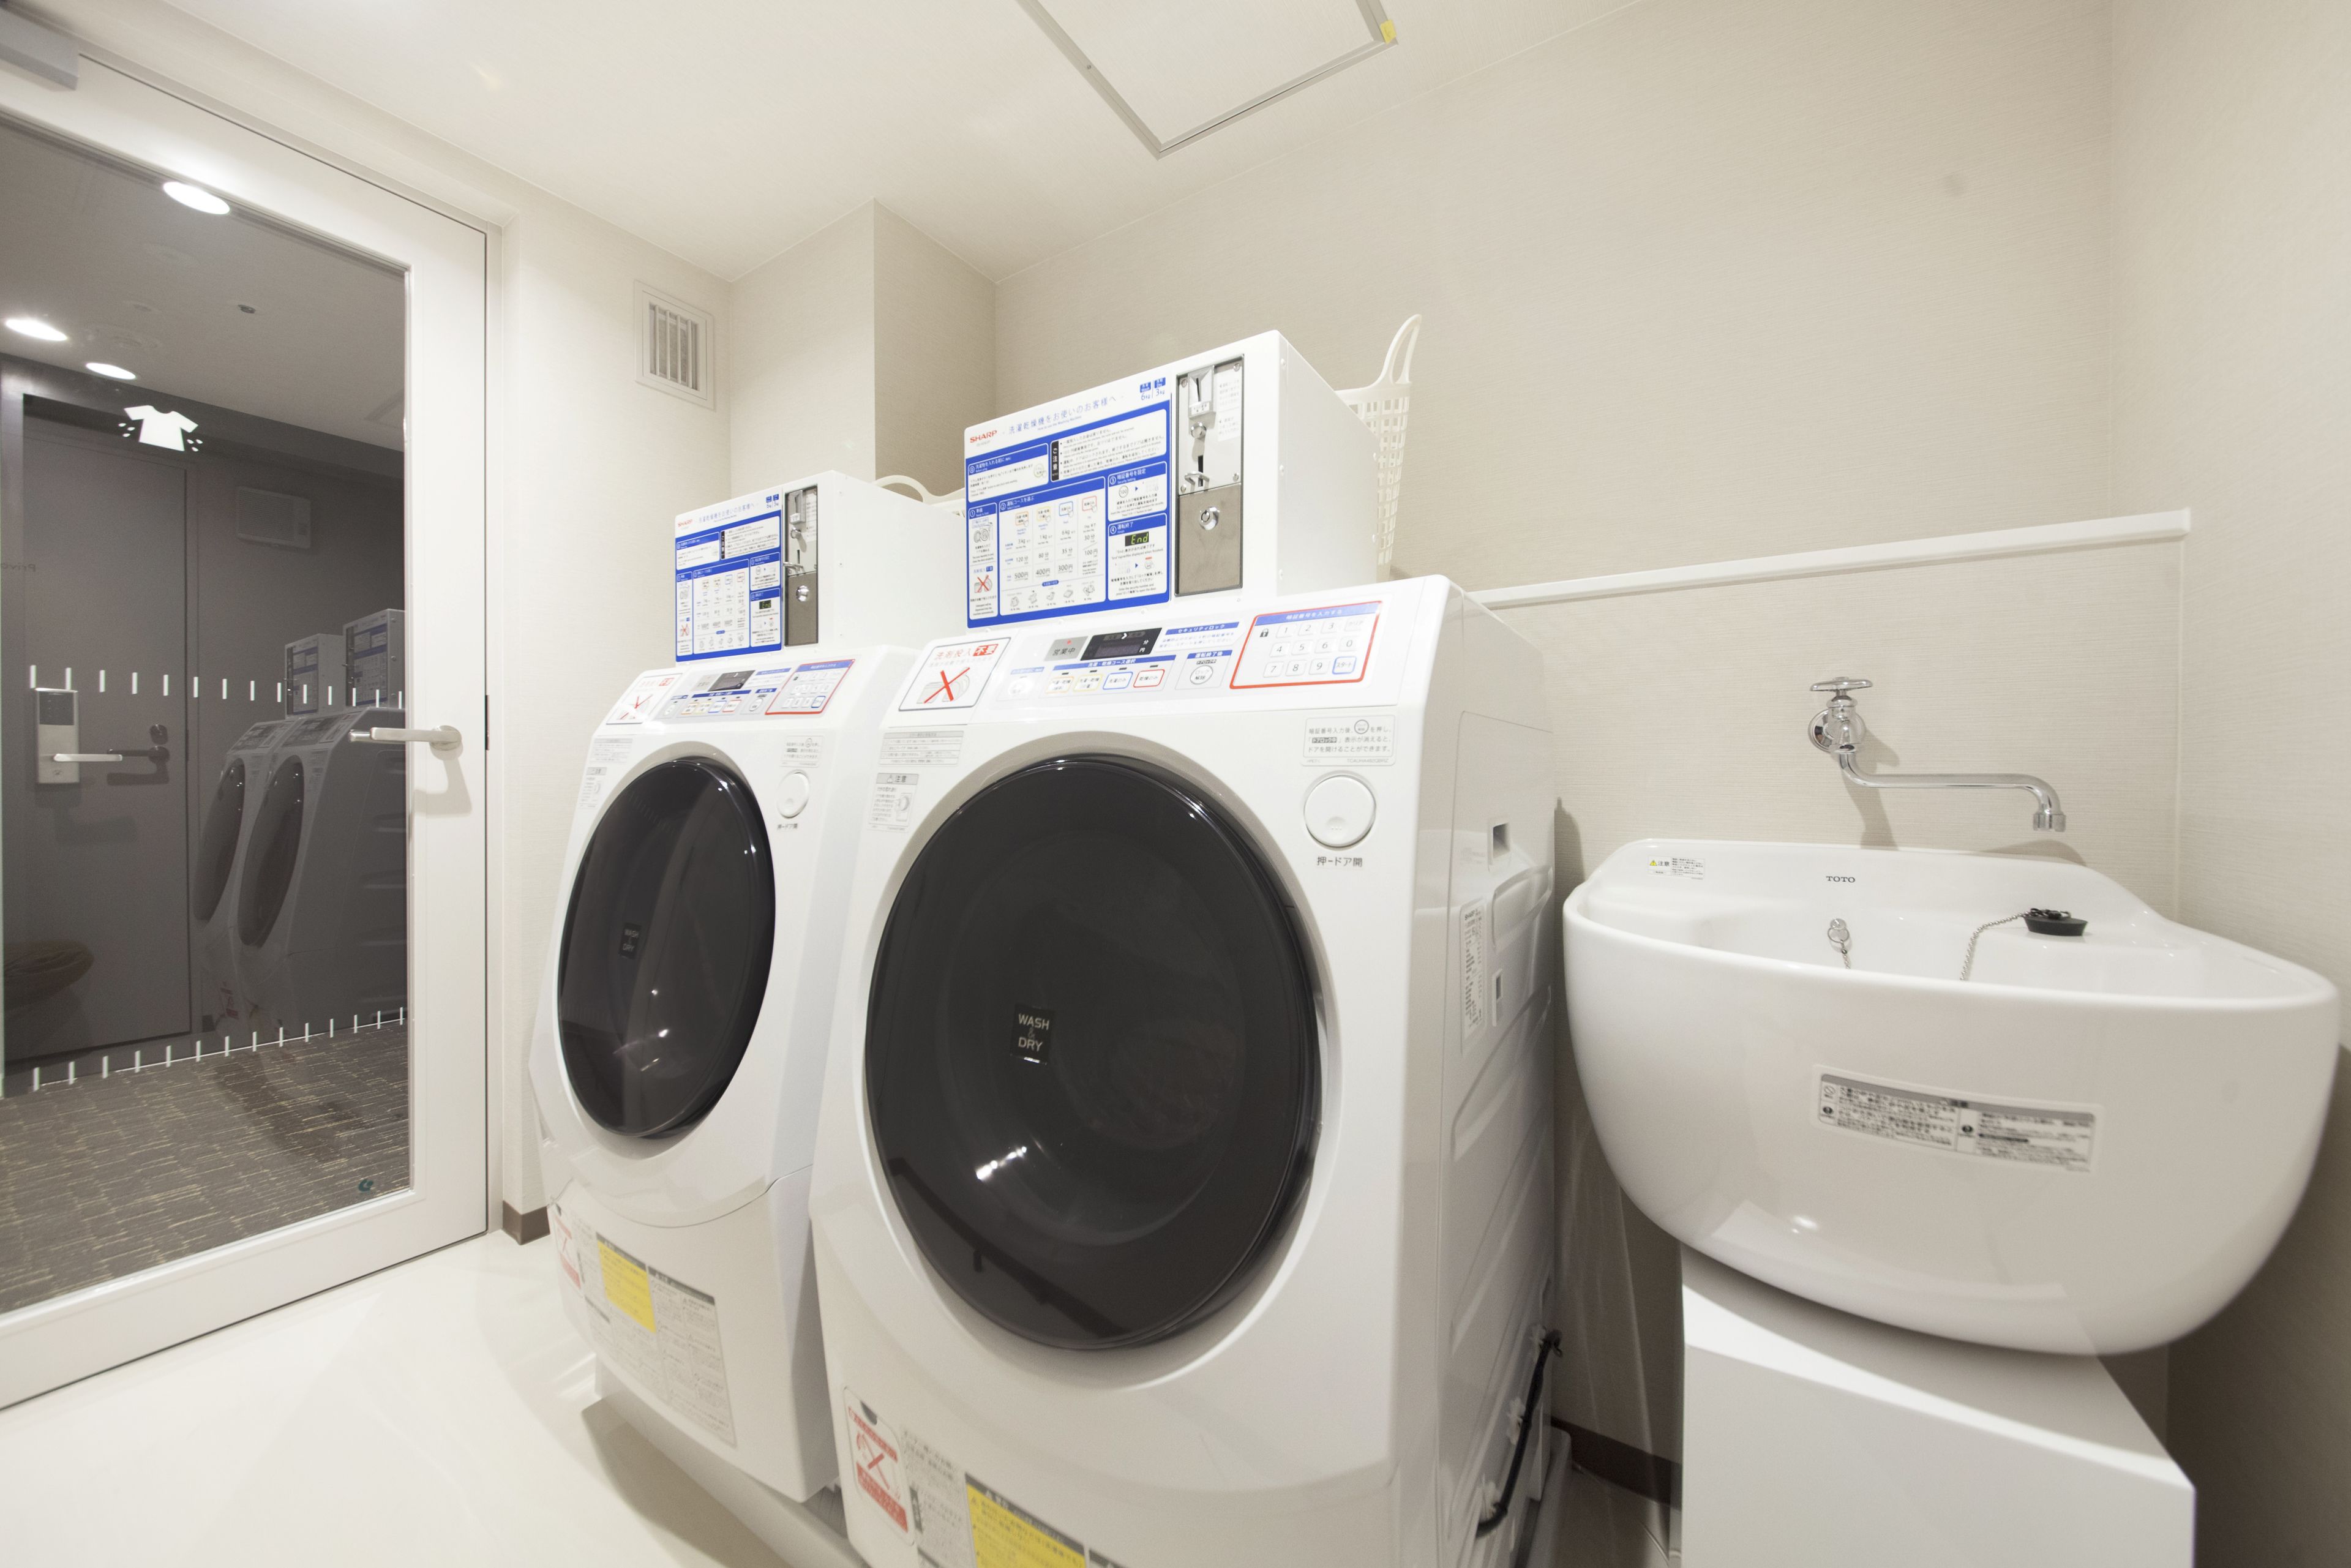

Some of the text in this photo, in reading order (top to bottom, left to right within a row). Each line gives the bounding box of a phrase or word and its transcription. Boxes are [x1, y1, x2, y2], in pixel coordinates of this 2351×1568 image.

[970, 430, 997, 443] SHARP
[1131, 533, 1148, 544] End
[1286, 609, 1342, 620] 暗証番号を入力する
[1177, 625, 1225, 633] セキュリティロック
[1052, 647, 1076, 656] 営業中
[1018, 1013, 1050, 1030] WASH
[1018, 1037, 1043, 1052] DRY
